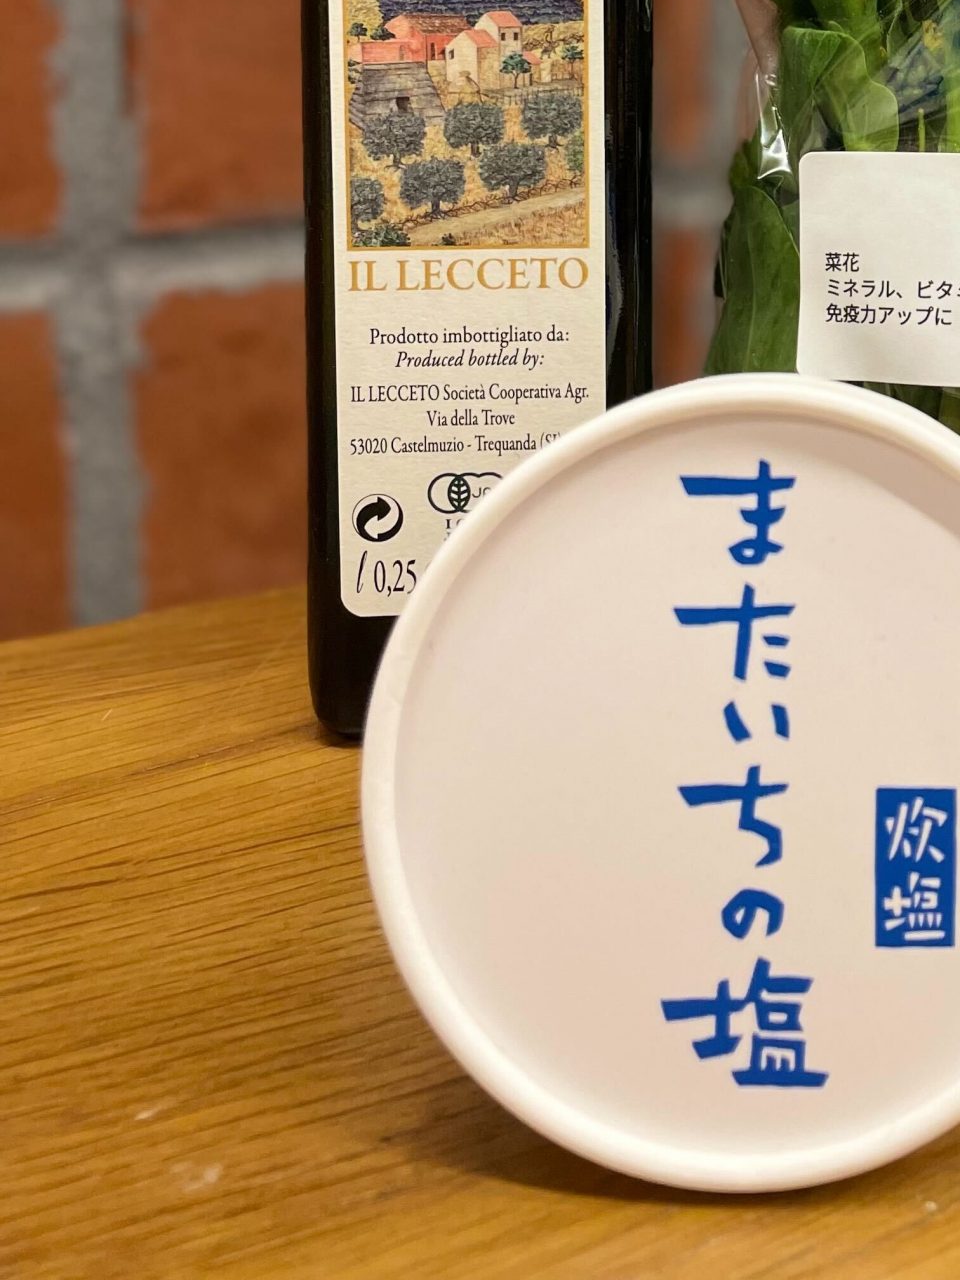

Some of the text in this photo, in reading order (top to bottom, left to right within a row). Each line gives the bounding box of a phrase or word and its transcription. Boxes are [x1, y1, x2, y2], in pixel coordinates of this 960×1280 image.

[825, 252, 859, 272] 菜花
[348, 257, 589, 291] IL LECCETO
[825, 304, 952, 327] 免疫力アップに
[370, 325, 569, 347] Prodotto imbottigliato da:
[395, 349, 545, 370] Produced bottled by:
[351, 382, 589, 404] IL LECCETO Società Cooperativa Agr.
[427, 409, 515, 426] Via della Trove
[350, 438, 387, 455] 53020
[391, 436, 464, 454] Castelmuzio
[477, 434, 537, 456] Trequanda
[374, 559, 416, 597] 0,25
[660, 458, 829, 1088] またいちの塩
[882, 795, 949, 942] 炊塩
